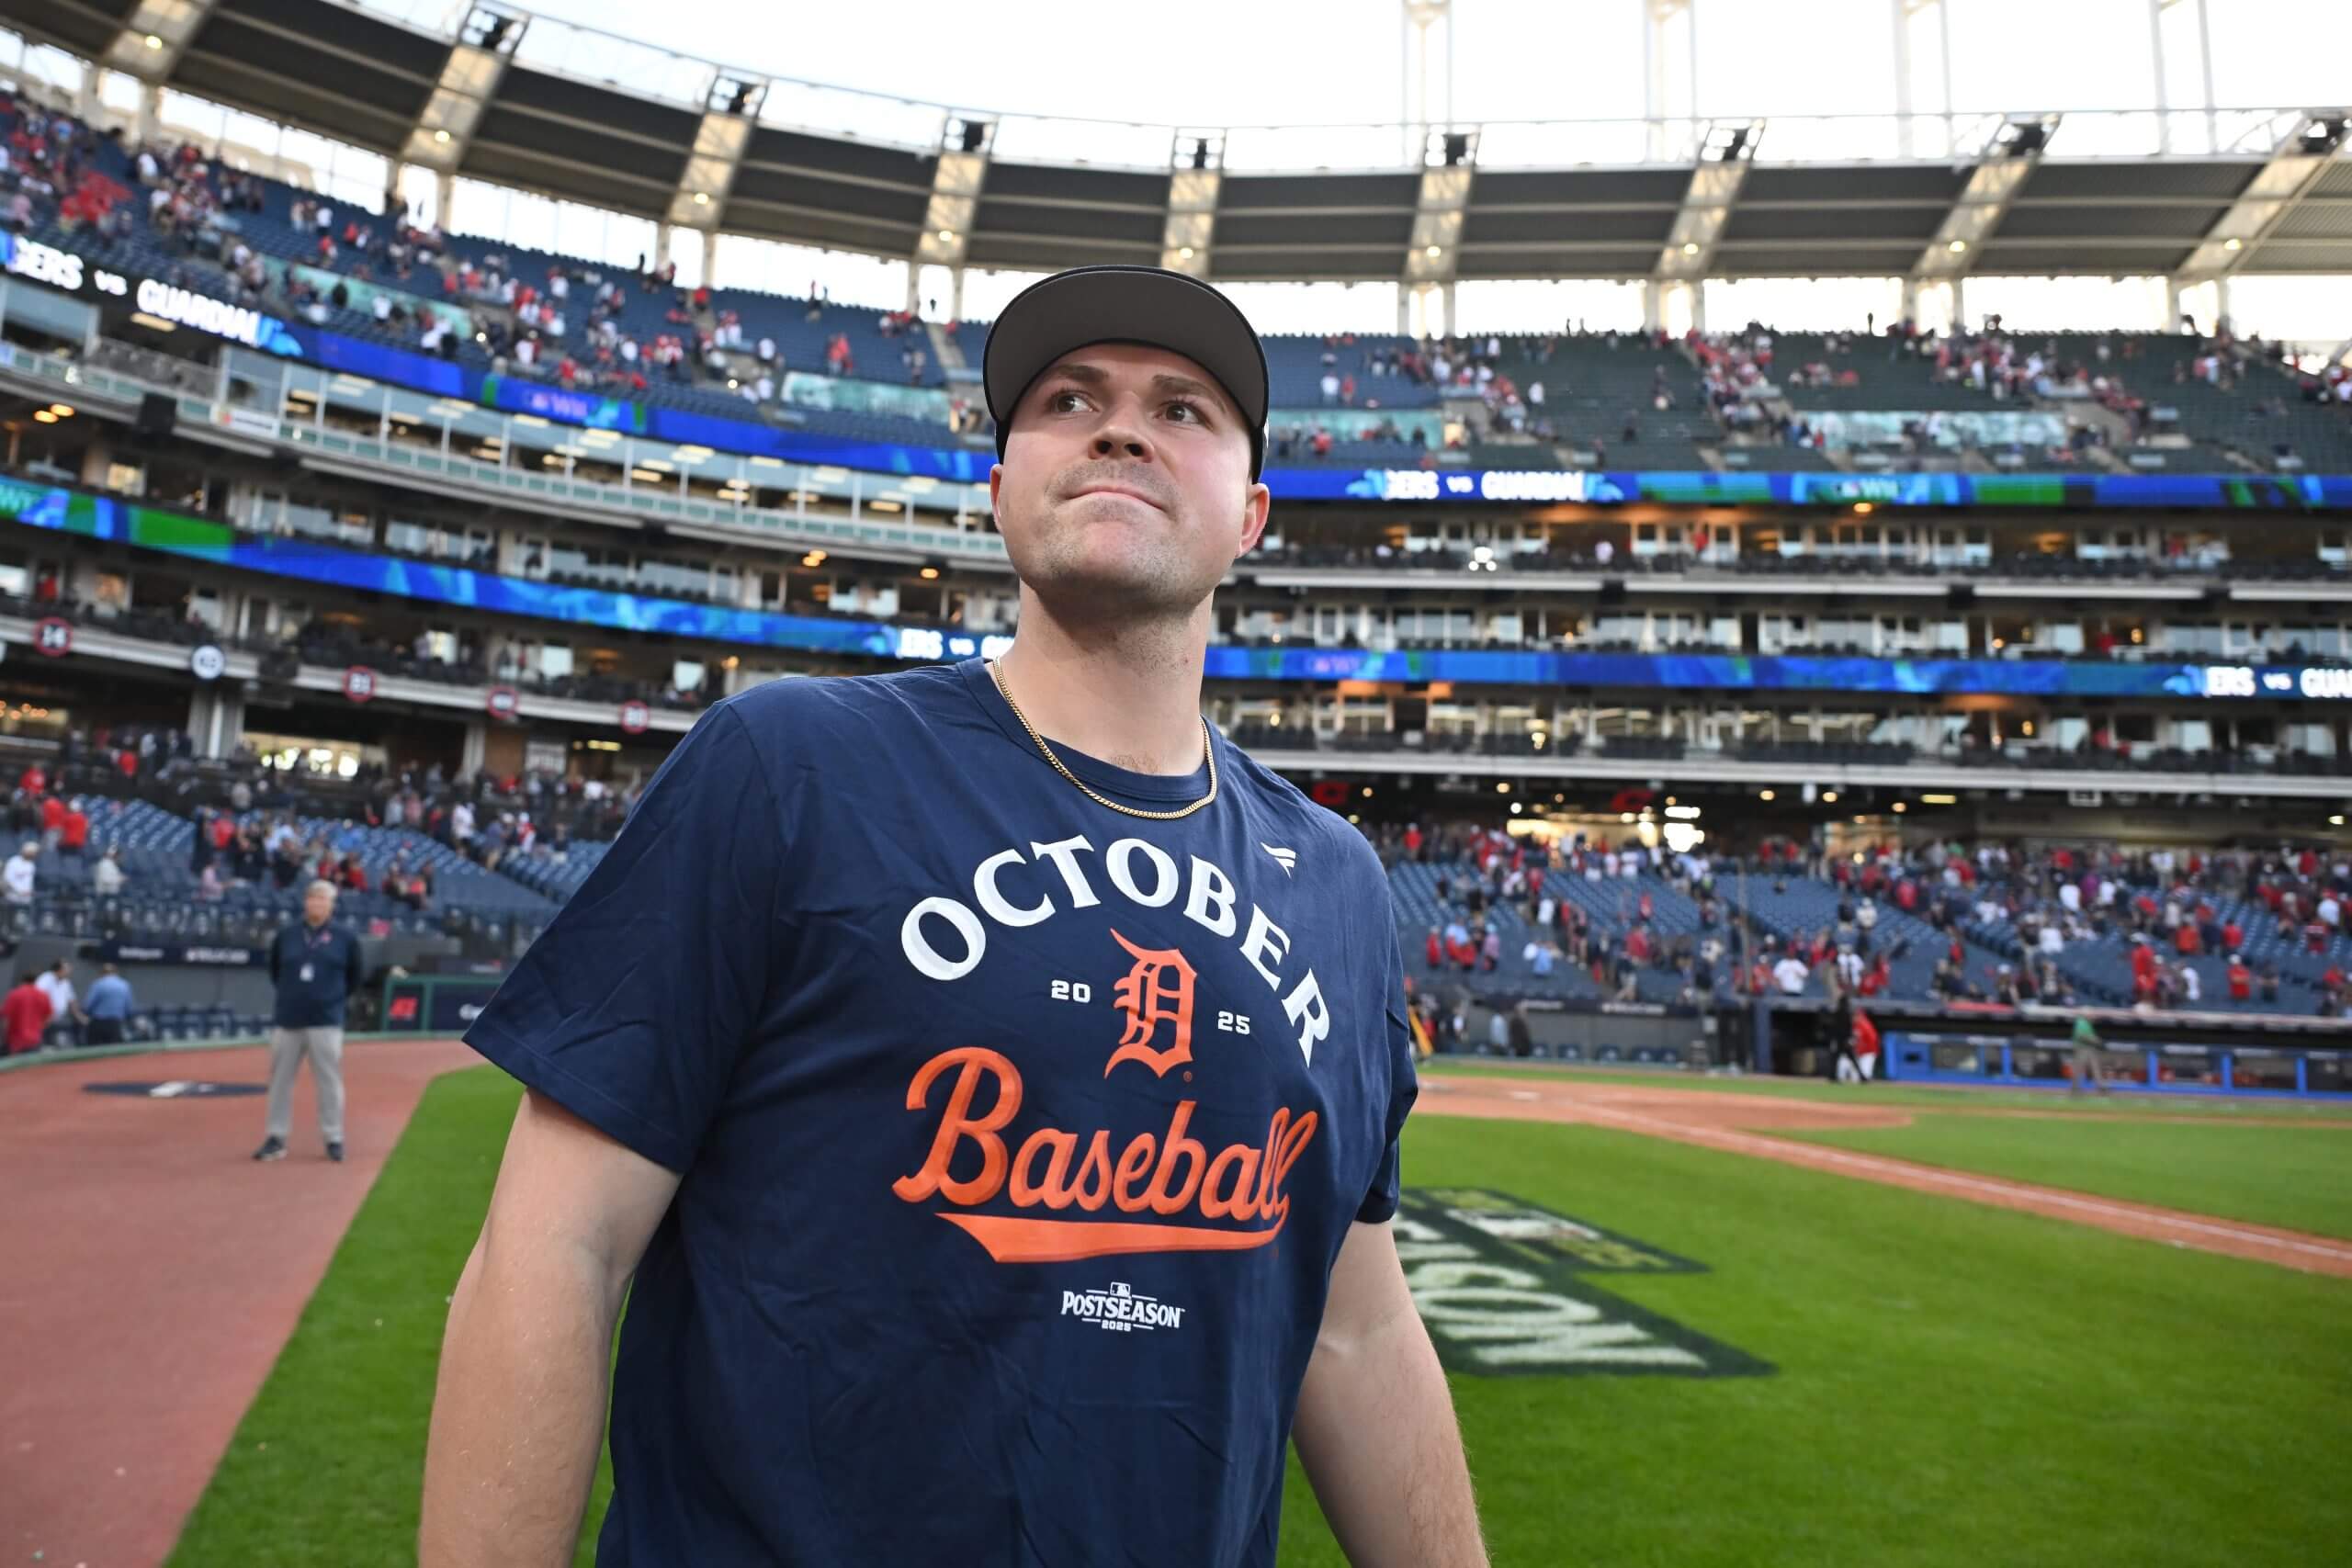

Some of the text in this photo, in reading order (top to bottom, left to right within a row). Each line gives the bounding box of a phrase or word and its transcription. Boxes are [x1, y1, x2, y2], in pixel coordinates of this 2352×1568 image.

[901, 834, 1329, 1067] OCTOBER
[1051, 979, 1091, 1003] 20
[1217, 1010, 1250, 1035] 25
[892, 1046, 1317, 1224] Baseball
[1061, 1291, 1182, 1328] POSTSEASON
[1102, 1320, 1131, 1332] 2025
